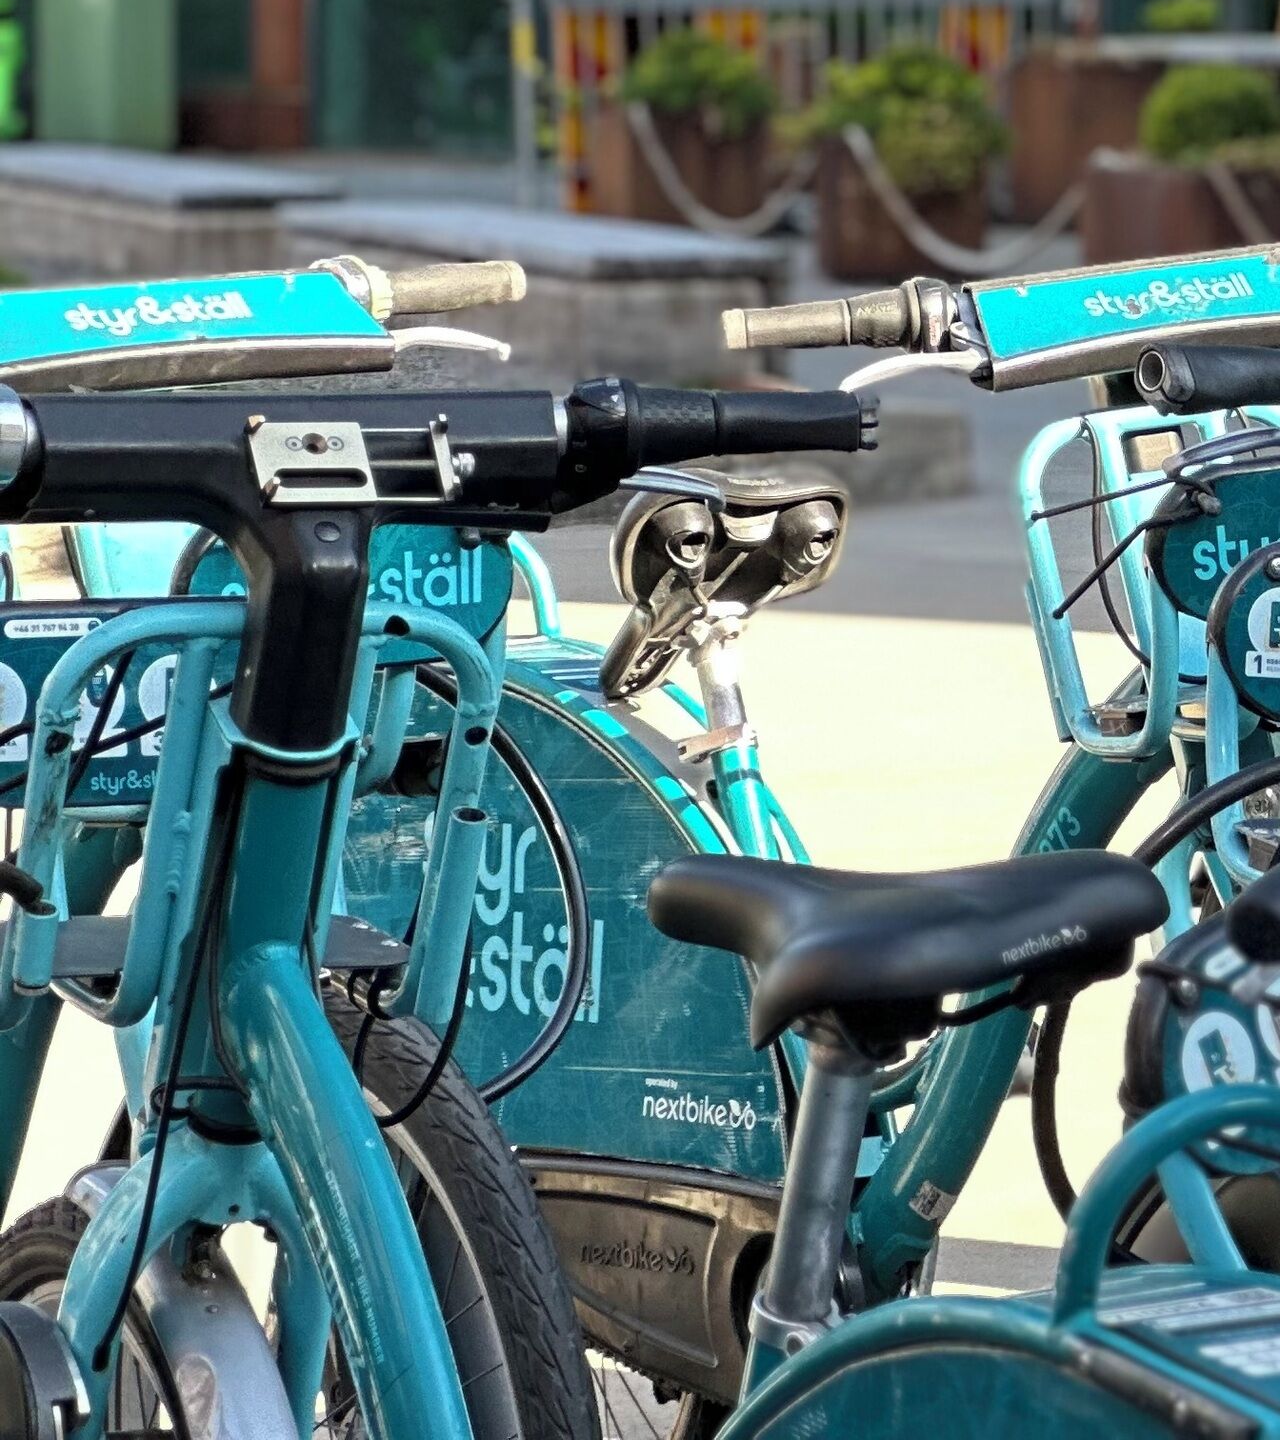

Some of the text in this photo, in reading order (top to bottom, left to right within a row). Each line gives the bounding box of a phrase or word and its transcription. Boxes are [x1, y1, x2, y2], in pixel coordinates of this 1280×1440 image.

[1084, 271, 1255, 320] styr&ställ
[64, 292, 253, 336] styr&ställ
[1253, 654, 1263, 674] 1
[1002, 933, 1062, 966] nextbike
[642, 1093, 727, 1127] nextbike
[581, 1240, 665, 1275] nextbike
